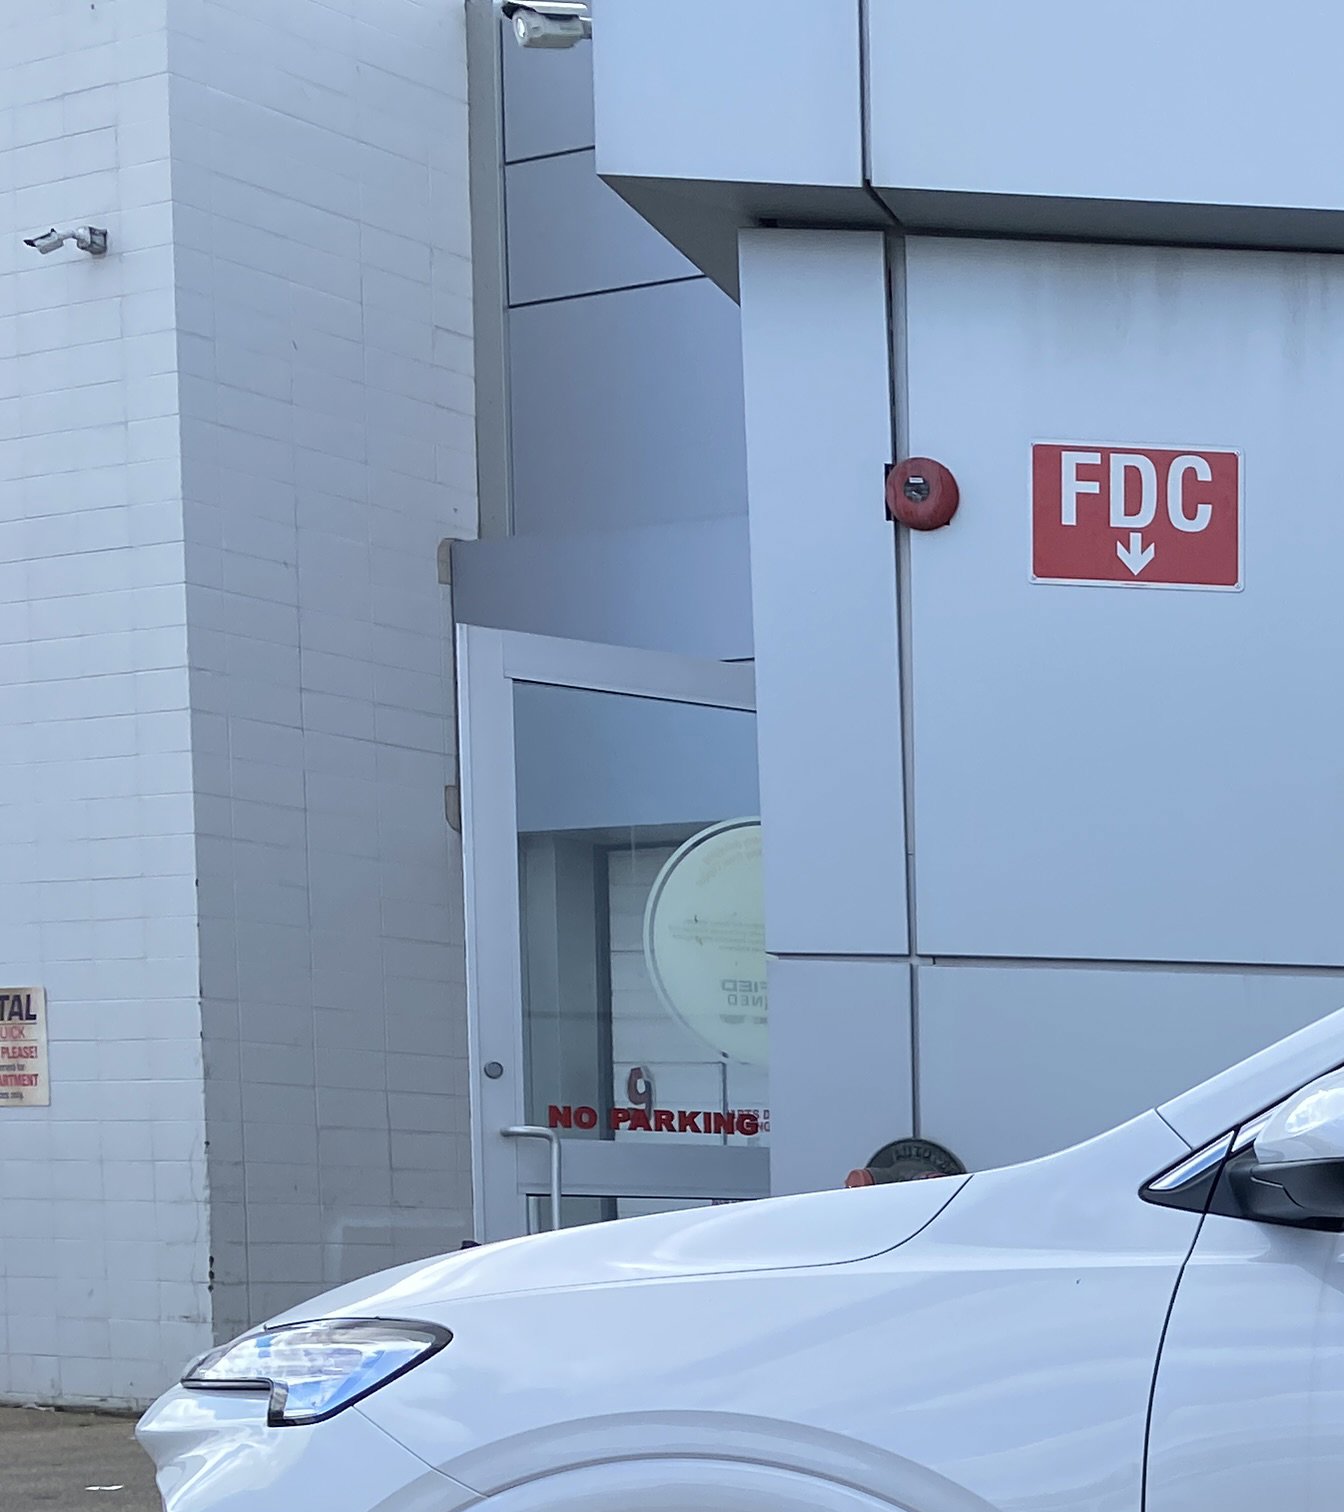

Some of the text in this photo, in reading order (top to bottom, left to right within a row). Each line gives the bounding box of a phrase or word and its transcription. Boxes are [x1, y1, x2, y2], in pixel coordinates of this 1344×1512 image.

[1061, 451, 1212, 533] FDC
[548, 1105, 598, 1130] NO
[610, 1108, 759, 1136] PARKING
